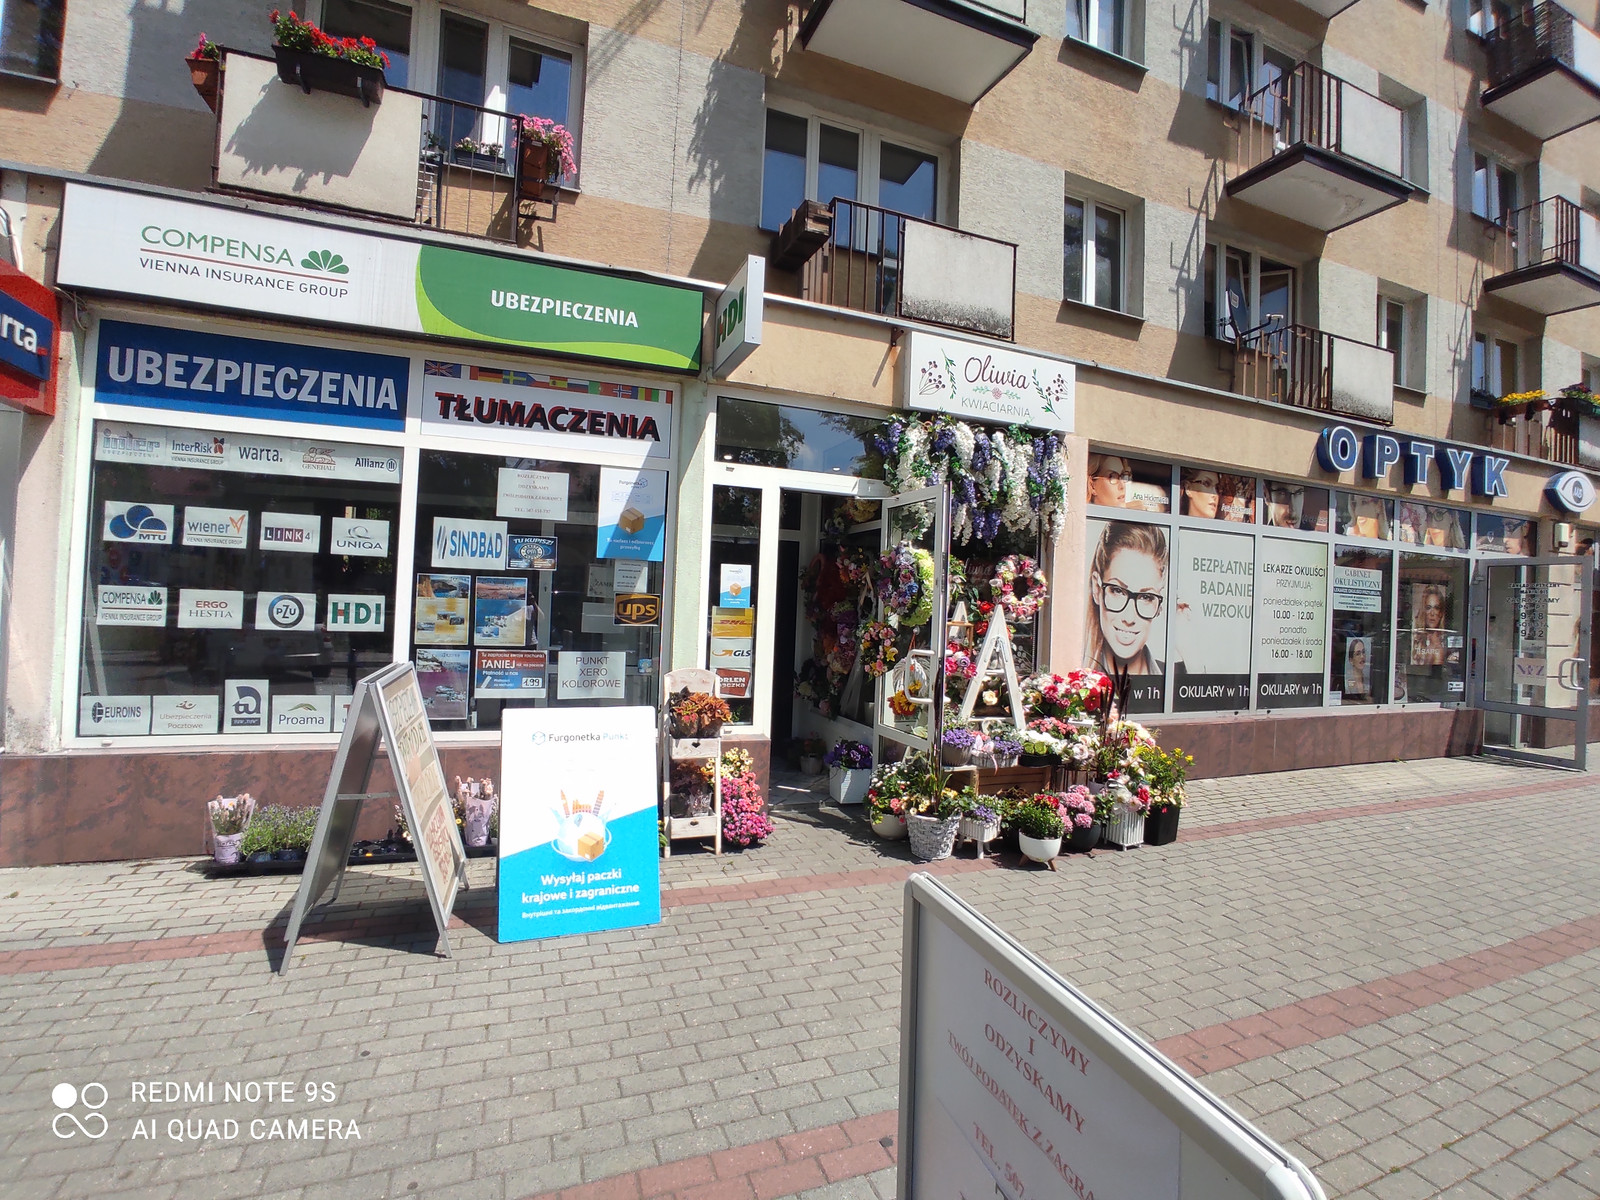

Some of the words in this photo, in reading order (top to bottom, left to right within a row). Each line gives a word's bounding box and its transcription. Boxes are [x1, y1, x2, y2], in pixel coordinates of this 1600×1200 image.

[141, 225, 294, 267] COMPENSA
[140, 257, 201, 276] VIENNA
[205, 267, 295, 292] INSURANCE
[299, 281, 349, 298] GROUP
[490, 289, 639, 328] UBEZPIECZENIA
[716, 286, 744, 350] HDI
[107, 346, 398, 411] UBEZPIECZENIA
[964, 355, 1030, 389] Oliwia
[961, 397, 1030, 417] KWIACIARNIA
[435, 391, 661, 442] TŁUMACZENIA
[172, 439, 212, 454] InterRisk
[302, 463, 336, 471] GENERALI
[355, 458, 385, 469] Allianz
[1318, 425, 1510, 497] OPTYK
[139, 533, 167, 541] MTU
[450, 529, 502, 559] SINDBAD
[336, 540, 383, 550] UNIQA
[1193, 557, 1253, 576] BEZPŁATNE
[1263, 563, 1293, 574] LEKARZE
[1294, 564, 1326, 577] OKULIŚCI
[1344, 568, 1371, 578] GABINET
[1200, 580, 1253, 597] BADANIE
[1334, 577, 1380, 589] OKULISTYCZNY
[102, 591, 146, 604] COMPENSA
[196, 601, 228, 609] ERGO
[619, 603, 656, 620] ups
[1202, 602, 1252, 619] WZROKU
[189, 609, 233, 618] HESTIA
[331, 602, 382, 625] HDI
[1273, 609, 1290, 620] 10.00
[1297, 611, 1314, 620] 12.00
[1279, 626, 1307, 634] ponadto
[1262, 636, 1301, 646] poniedziałek
[1306, 637, 1323, 646] środa
[733, 649, 751, 657] GLS
[1271, 649, 1289, 658] 16.00
[1296, 649, 1312, 659] 18.00
[481, 659, 516, 669] TANIEJ
[575, 656, 609, 665] PUNKT
[578, 667, 608, 676] XERO
[562, 678, 621, 688] KOLOROWE
[1260, 683, 1300, 696] OKULARY
[1302, 686, 1310, 695] w
[1312, 683, 1322, 695] 1h
[1133, 690, 1144, 699] w
[1147, 686, 1160, 699] 1h
[1179, 685, 1224, 698] OKULARY
[1227, 688, 1235, 697] w
[1238, 684, 1249, 697] 1h
[104, 706, 142, 718] EUROINS
[278, 714, 325, 725] Proama
[548, 732, 601, 743] Furgonetka
[540, 871, 586, 887] Wysyłaj
[587, 868, 622, 882] paczki
[522, 890, 567, 905] krajowe
[569, 888, 573, 898] i
[575, 884, 640, 900] zagraniczne
[984, 968, 1091, 1076] ROZLICZYMY
[1028, 1036, 1035, 1056] I
[984, 1023, 1086, 1134] ODZYSKAMY
[947, 1029, 975, 1069] TWÓJ
[975, 1062, 1030, 1134] PODATEK
[1033, 1126, 1043, 1148] Z
